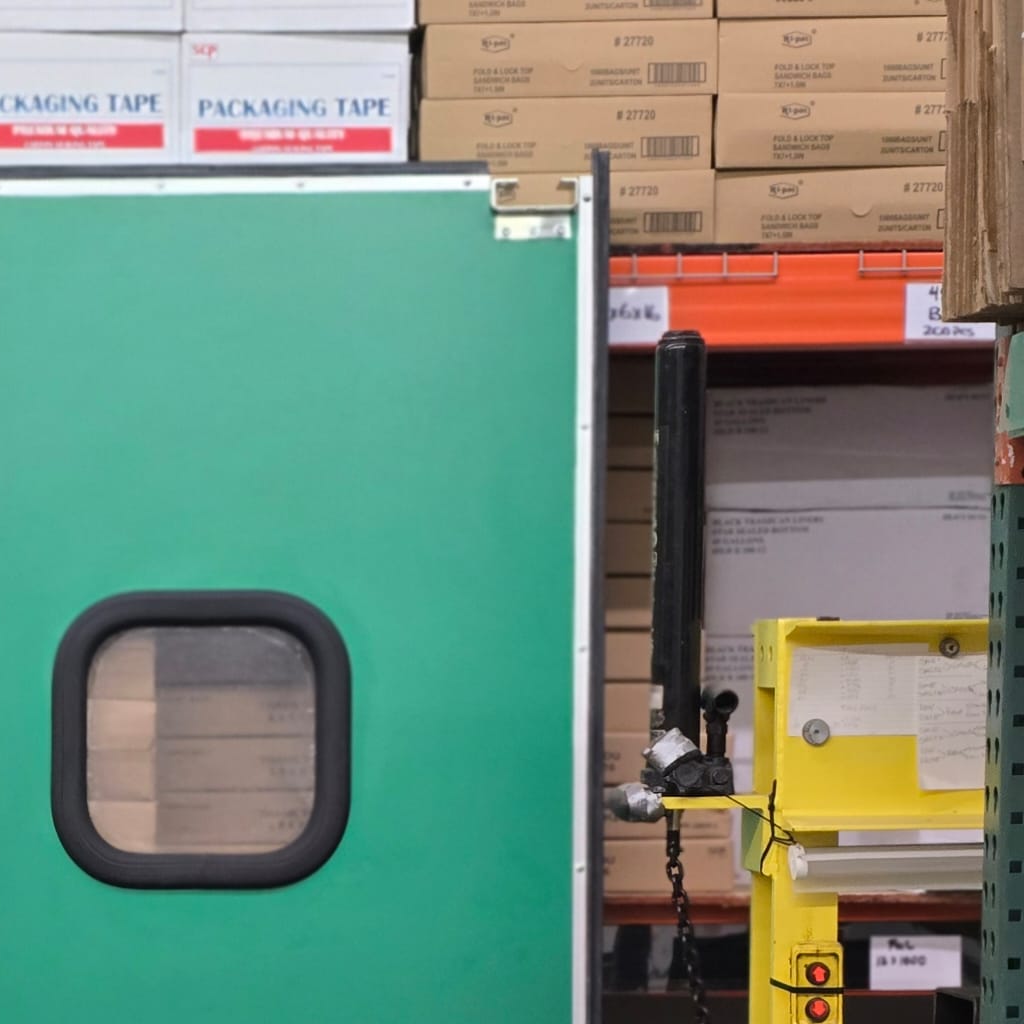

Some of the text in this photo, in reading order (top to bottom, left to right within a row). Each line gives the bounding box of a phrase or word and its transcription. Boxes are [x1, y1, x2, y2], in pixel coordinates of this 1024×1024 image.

[623, 35, 654, 47] 27720
[926, 31, 948, 42] 2772
[500, 67, 519, 75] LOCK
[520, 66, 534, 74] TOP
[774, 63, 794, 71] FOLD
[801, 63, 820, 71] LOCK
[821, 62, 836, 70] TOP
[107, 93, 162, 113] TAPE
[198, 98, 391, 118] PACKAGING TAPE
[626, 109, 656, 120] 27720
[924, 104, 947, 115] 2772
[773, 135, 792, 143] FOLD
[800, 134, 819, 142] LOCK
[476, 142, 495, 150] FOLD
[503, 142, 521, 150] LOCK
[522, 141, 537, 149] TOP
[628, 186, 659, 197] 27720
[913, 182, 943, 193] 27720
[760, 214, 780, 222] FOLD
[787, 213, 807, 221] LOCK
